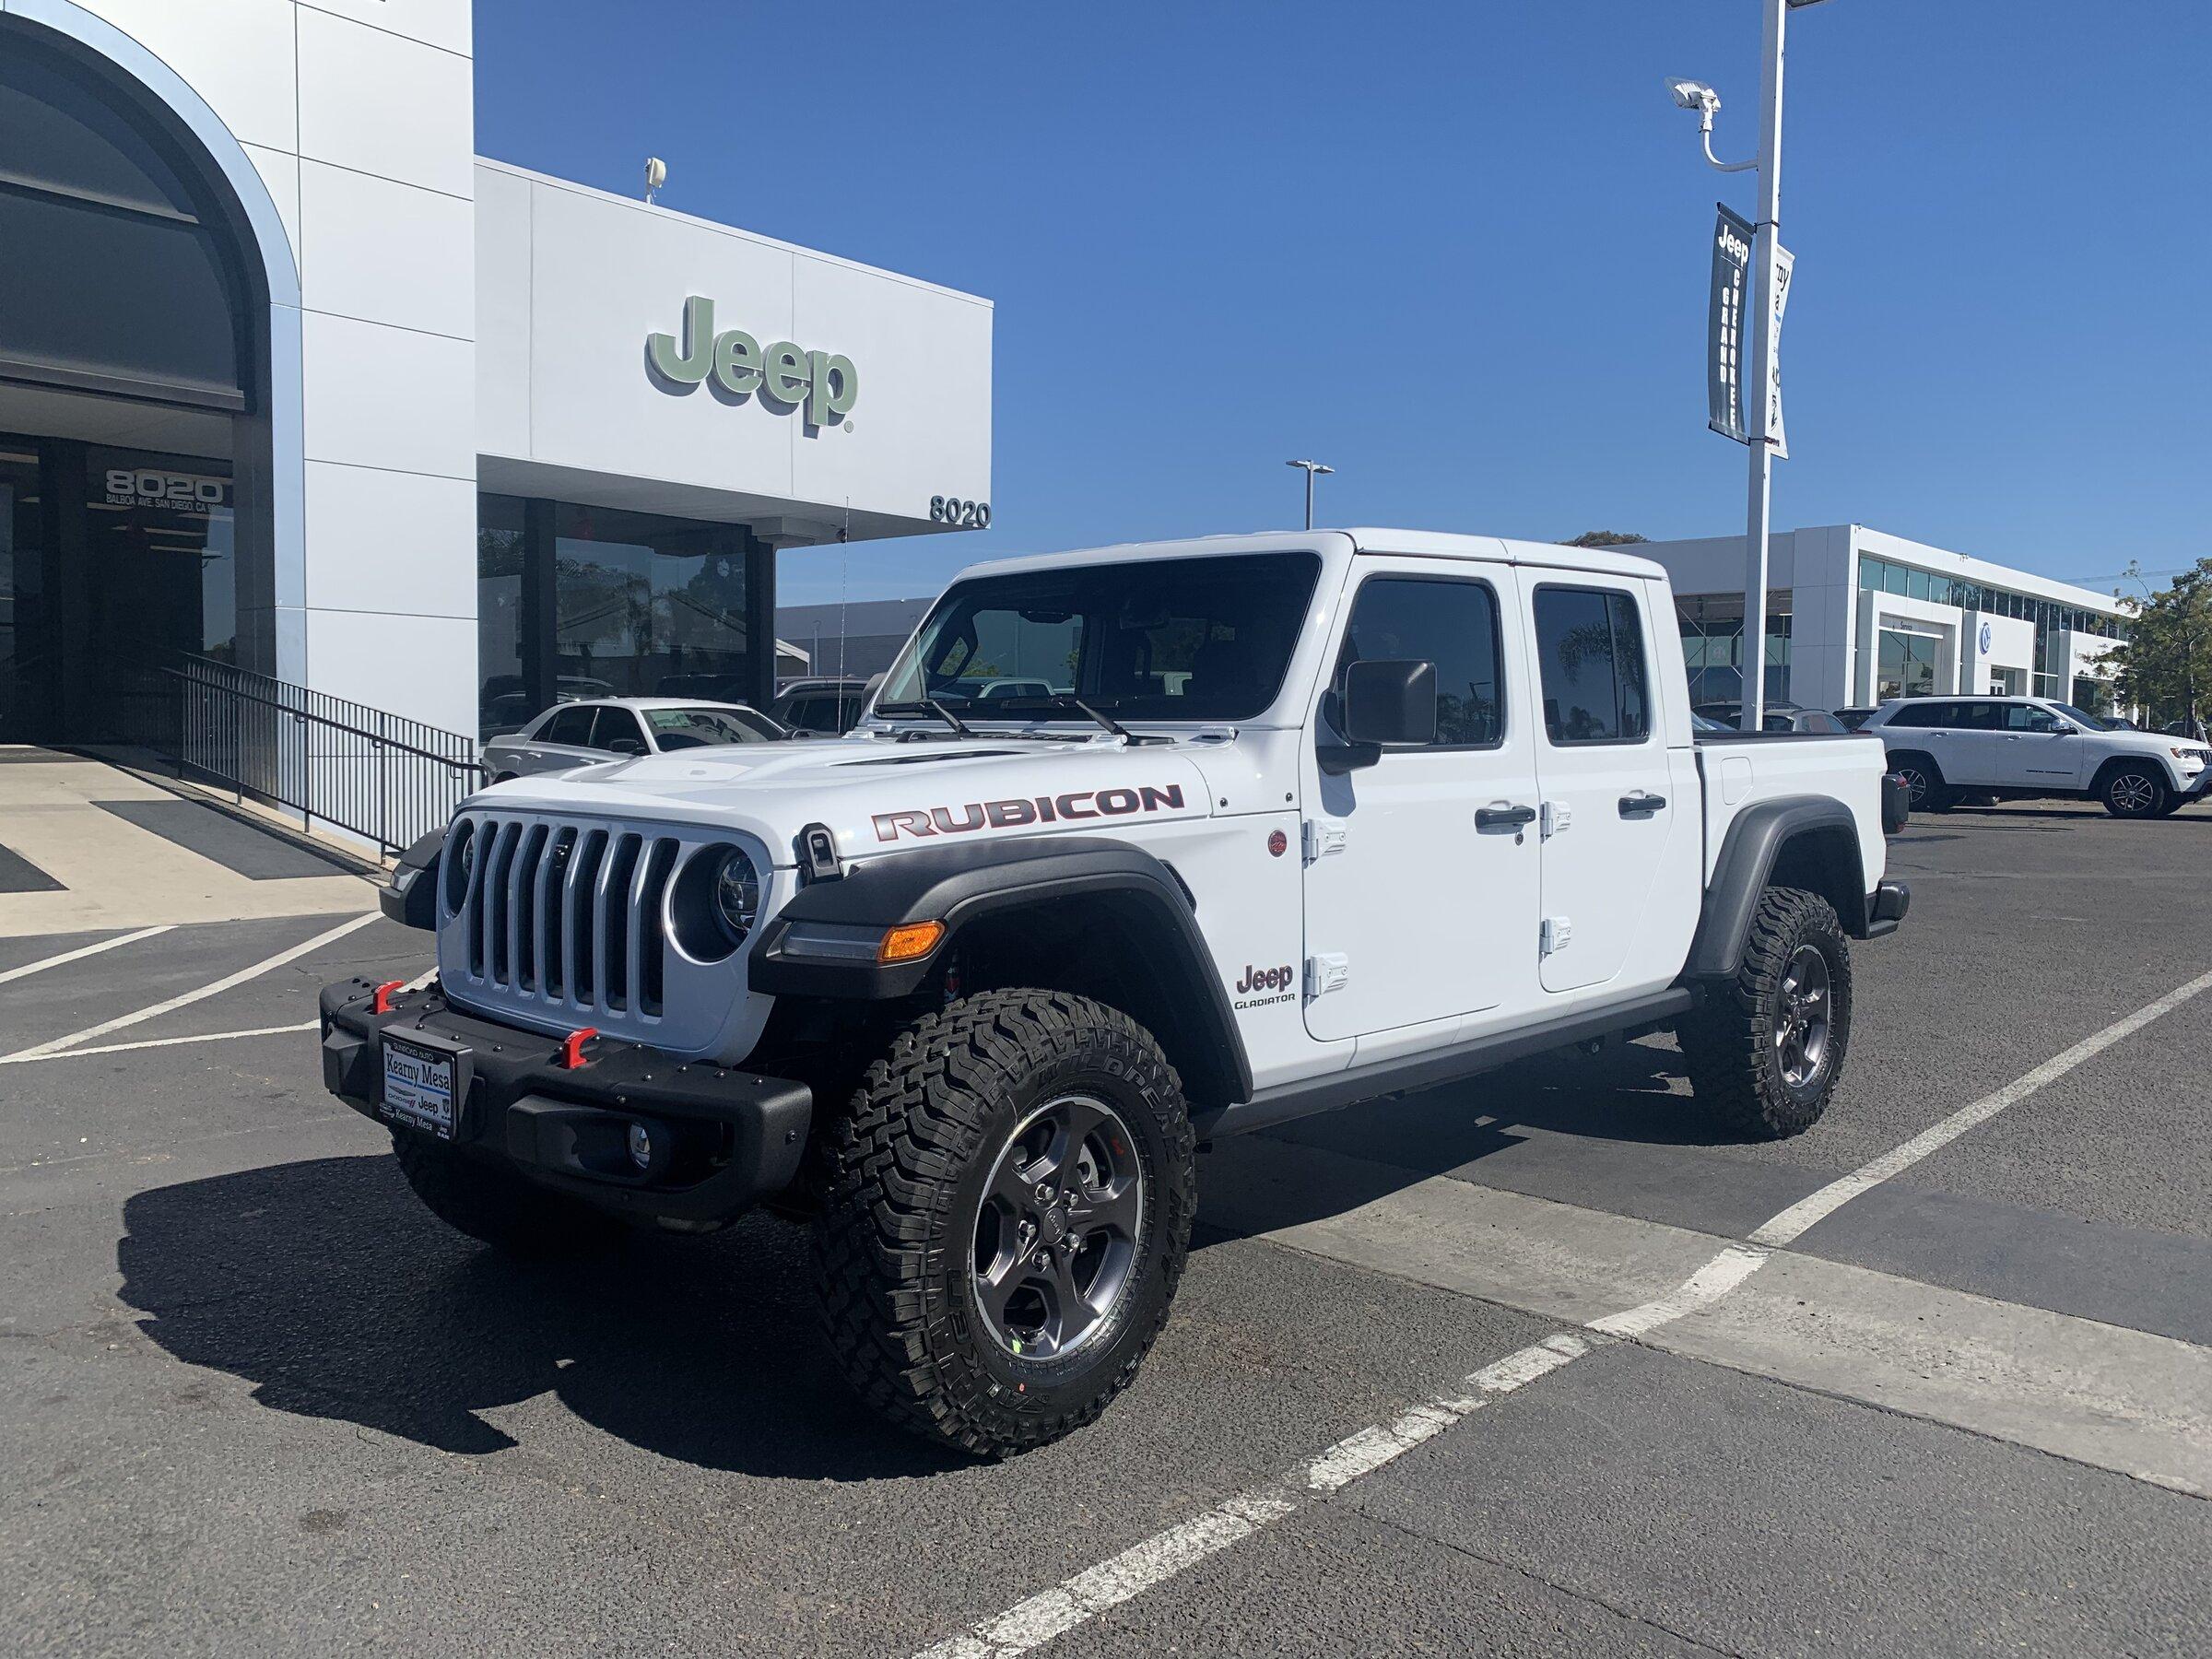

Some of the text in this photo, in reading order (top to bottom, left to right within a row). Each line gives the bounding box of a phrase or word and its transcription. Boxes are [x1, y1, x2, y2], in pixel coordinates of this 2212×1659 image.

[1718, 224, 1749, 267] Jeep
[1719, 287, 1730, 383] GRAND
[1728, 268, 1741, 430] CHEROKEE
[645, 295, 857, 426] Jeep
[106, 469, 223, 503] 8020
[106, 493, 135, 506] BALBOA
[155, 499, 171, 509] SAN
[195, 504, 206, 512] CA
[930, 495, 992, 528] 8020
[871, 783, 1185, 842] RUBICON
[1236, 964, 1293, 994] Jeep
[1234, 993, 1296, 1010] GLADIATOR
[386, 1053, 451, 1090] Kearny Mesa
[418, 1095, 439, 1117] Jeep
